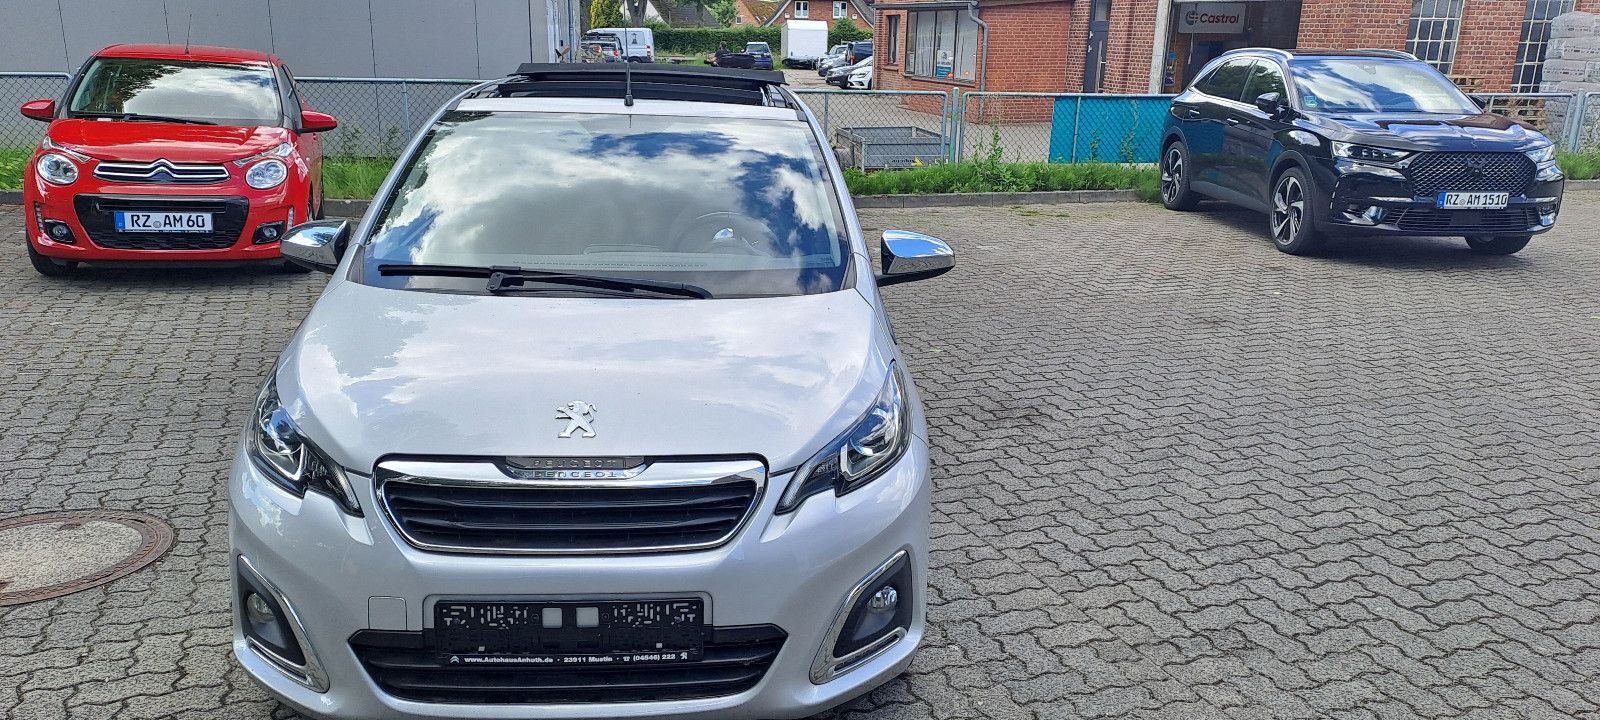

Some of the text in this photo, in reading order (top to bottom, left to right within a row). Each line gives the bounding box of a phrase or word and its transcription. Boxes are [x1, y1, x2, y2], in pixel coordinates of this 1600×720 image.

[1200, 13, 1240, 24] Castrol
[1445, 194, 1508, 206] RZ AM 1510
[130, 214, 206, 228] RZ AM 60
